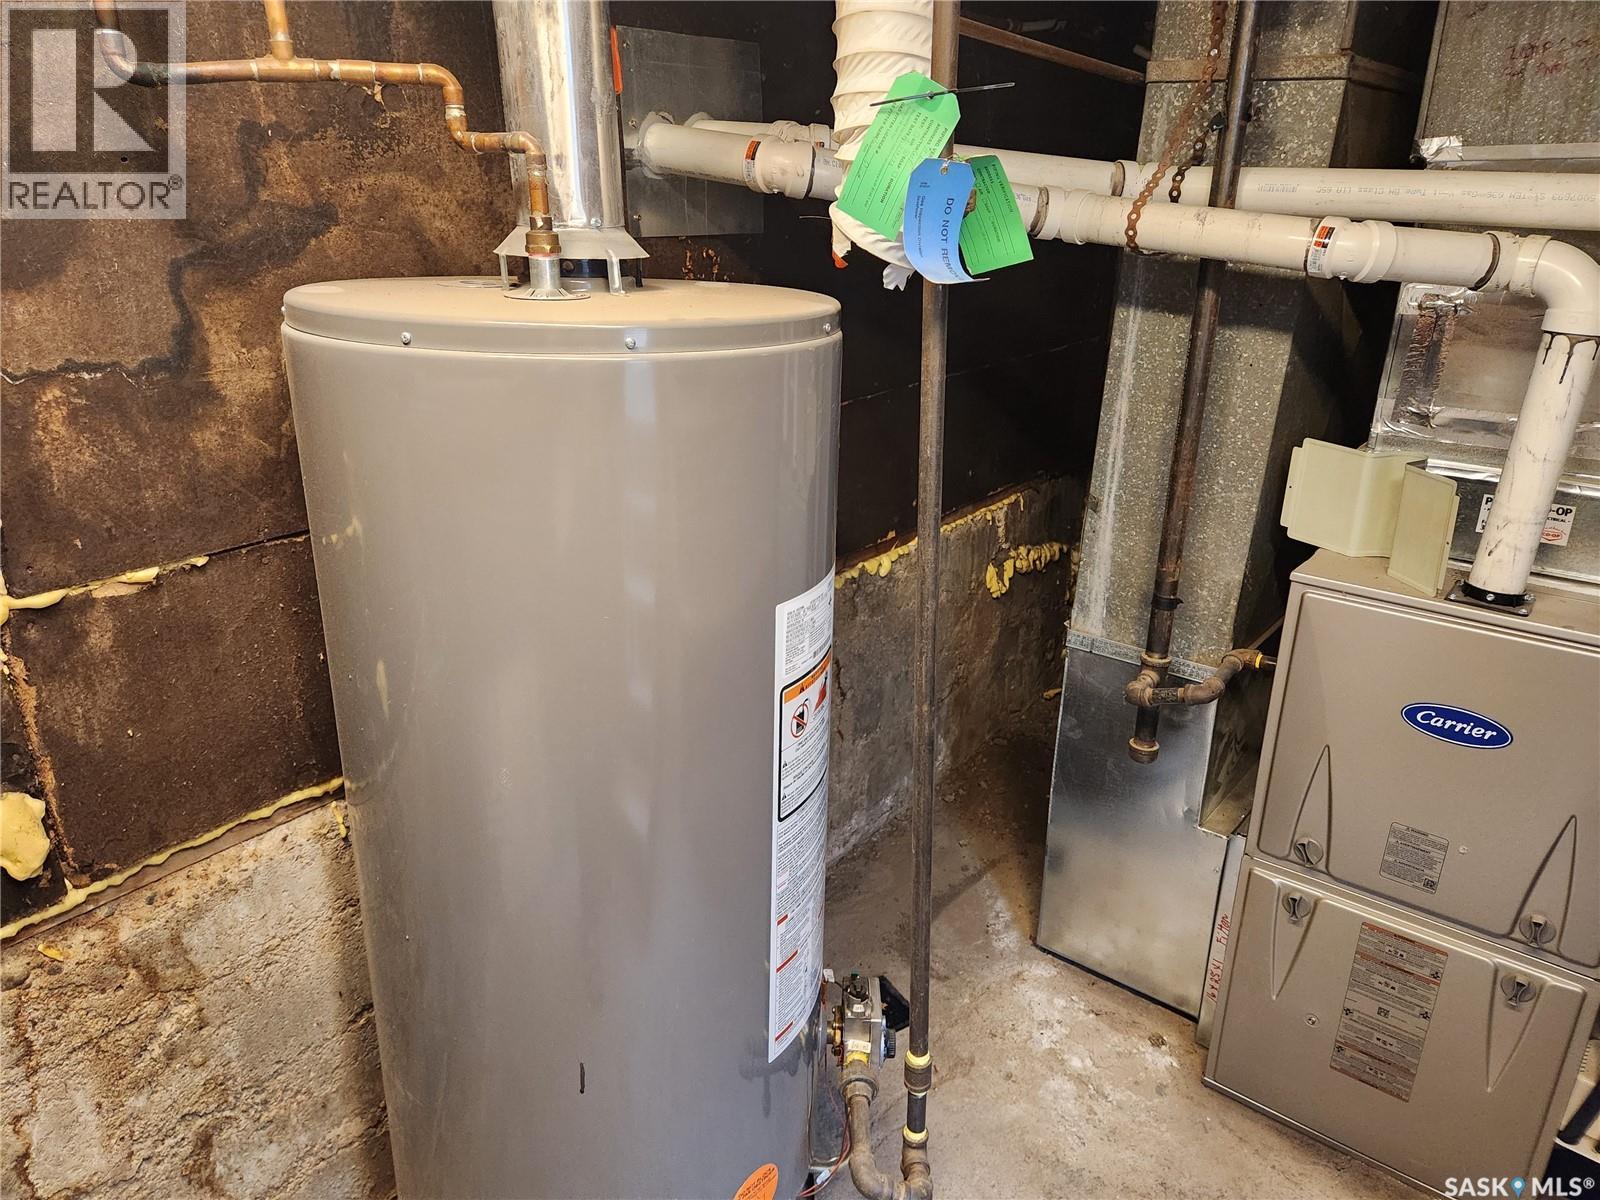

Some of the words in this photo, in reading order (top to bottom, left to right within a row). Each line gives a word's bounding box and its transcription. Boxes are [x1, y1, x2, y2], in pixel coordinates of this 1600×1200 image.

[944, 198, 954, 215] DO
[941, 219, 950, 244] NOT
[1549, 507, 1573, 517] -OP
[1416, 710, 1497, 741] Carrier
